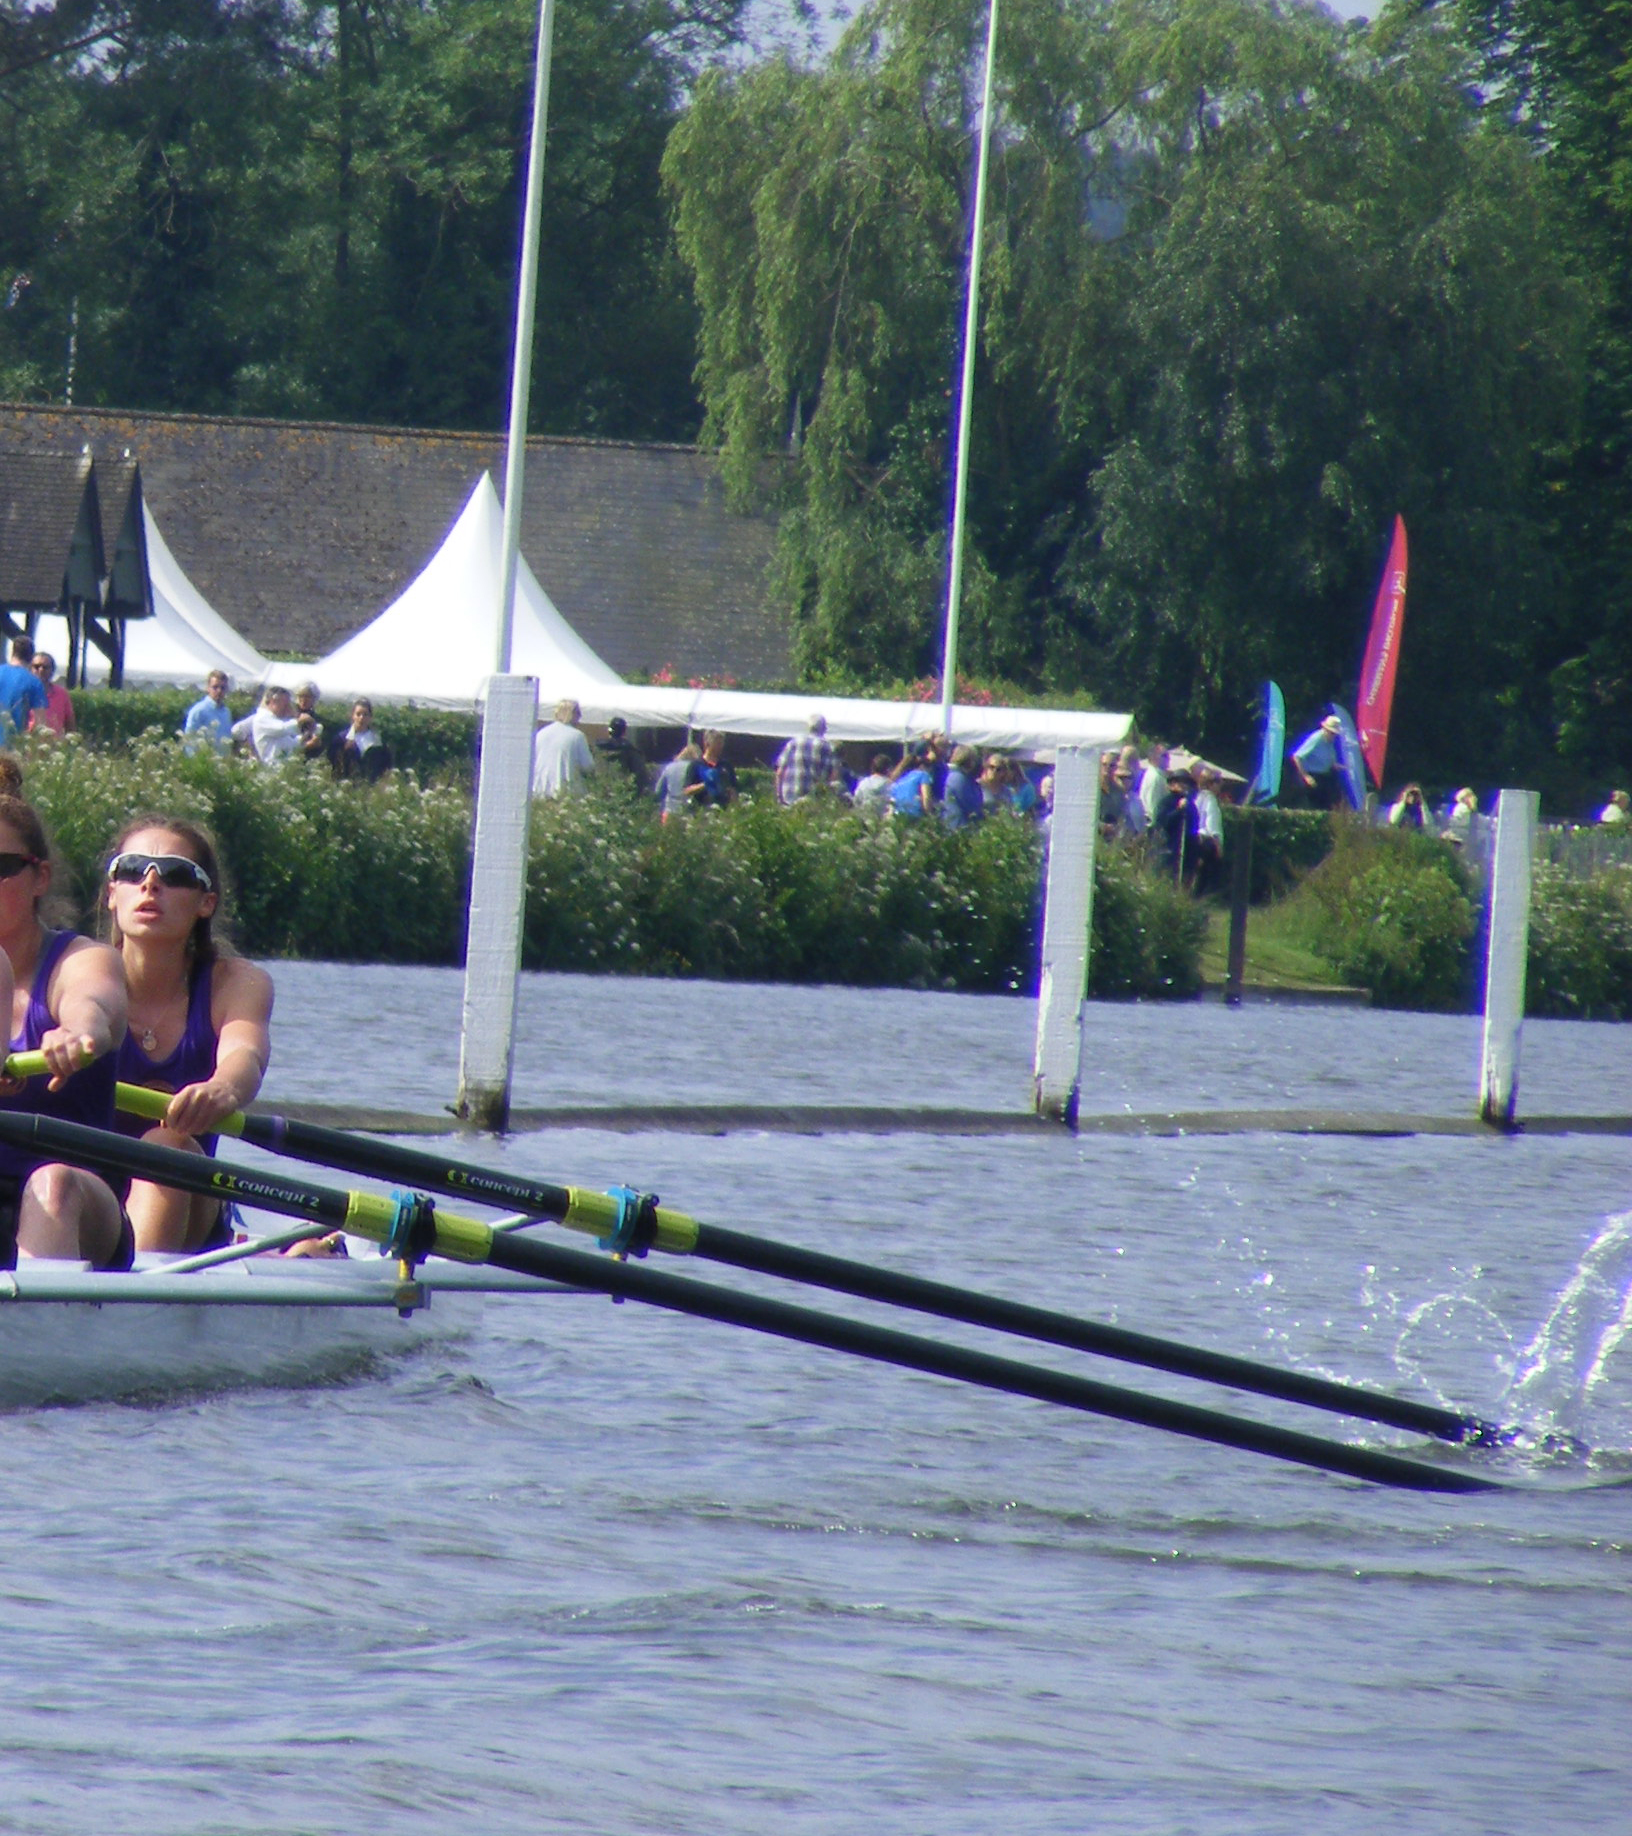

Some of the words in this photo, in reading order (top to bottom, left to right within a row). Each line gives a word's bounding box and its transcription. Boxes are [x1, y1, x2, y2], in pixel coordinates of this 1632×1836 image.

[238, 1180, 306, 1203] concept
[309, 1196, 320, 1208] 2
[470, 1176, 531, 1199] concept
[534, 1191, 544, 1202] 2
